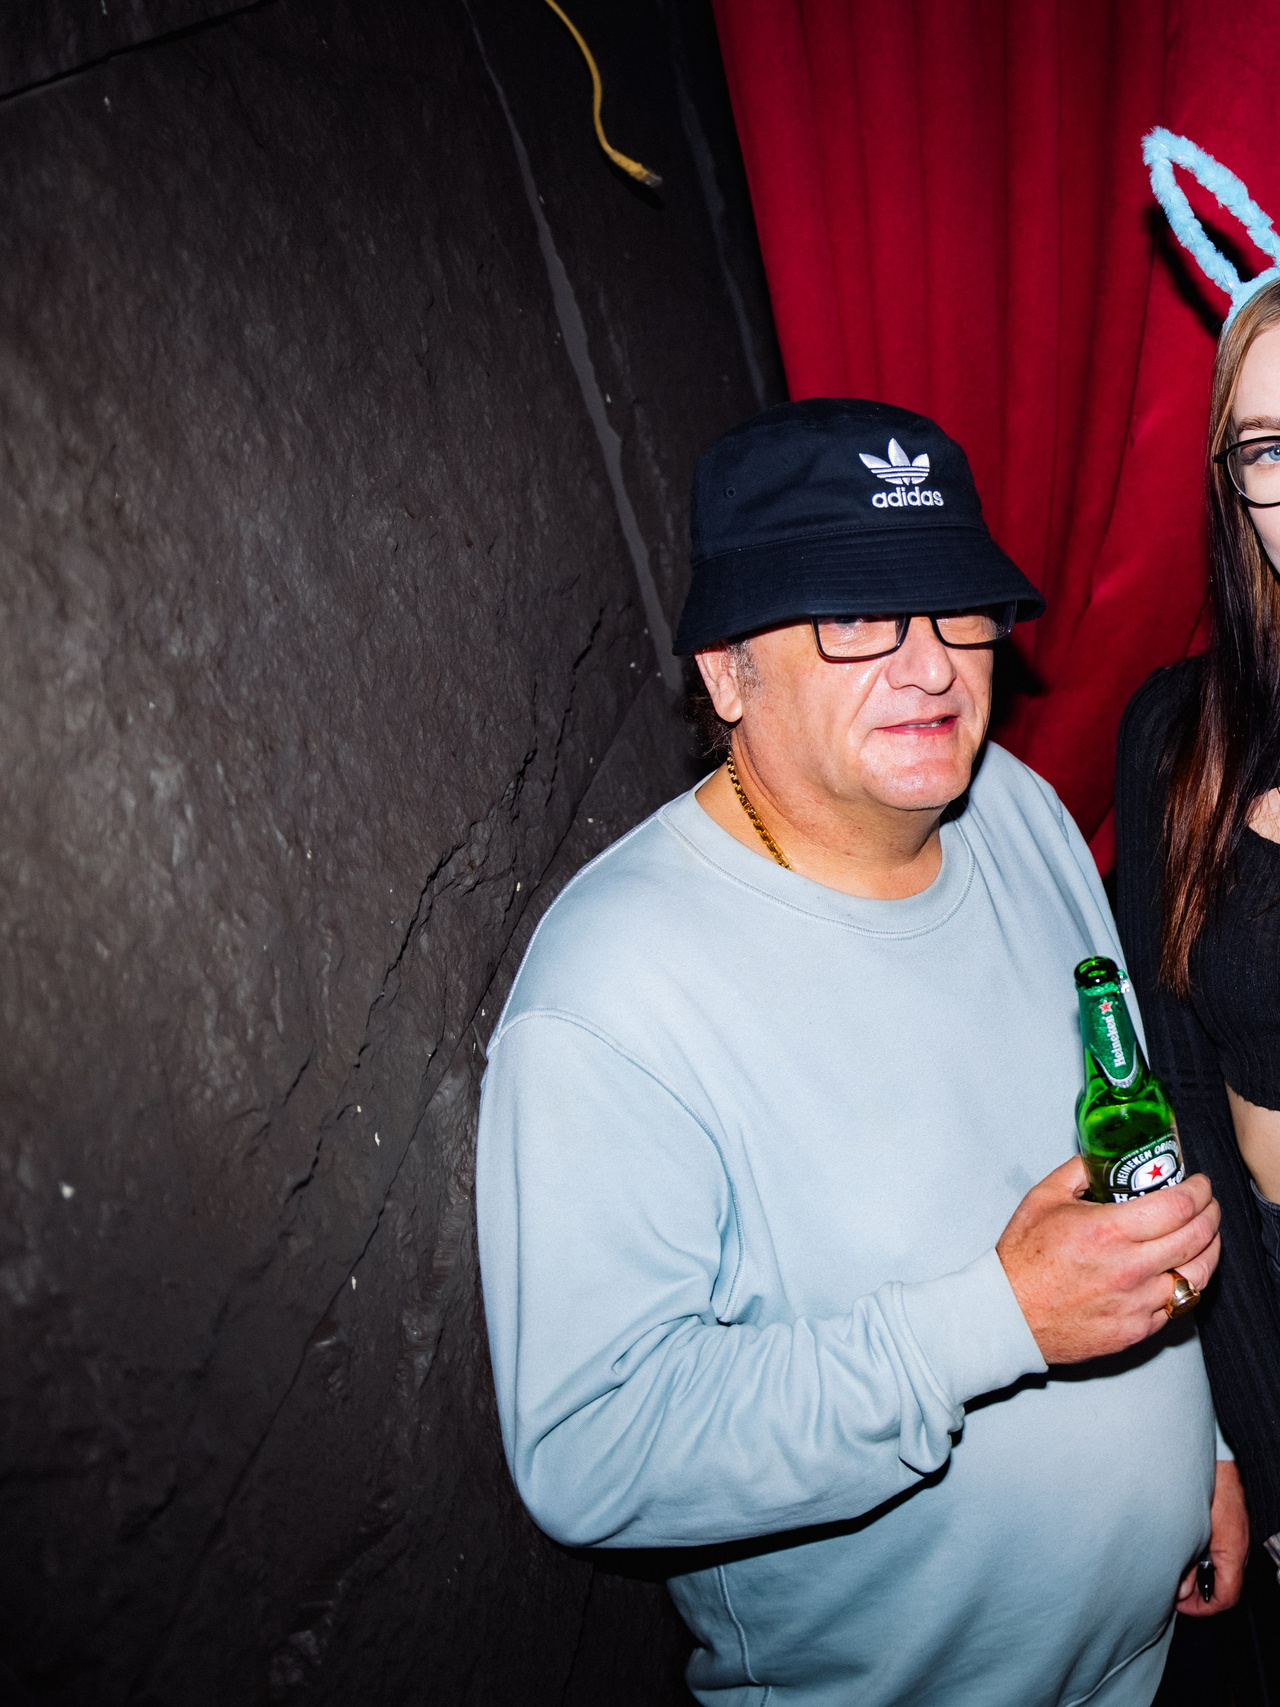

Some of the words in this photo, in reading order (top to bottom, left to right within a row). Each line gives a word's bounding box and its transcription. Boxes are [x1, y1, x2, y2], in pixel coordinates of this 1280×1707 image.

[871, 486, 944, 508] adidas
[1102, 1014, 1126, 1067] Heineken
[1116, 1149, 1153, 1186] HEINEKEN
